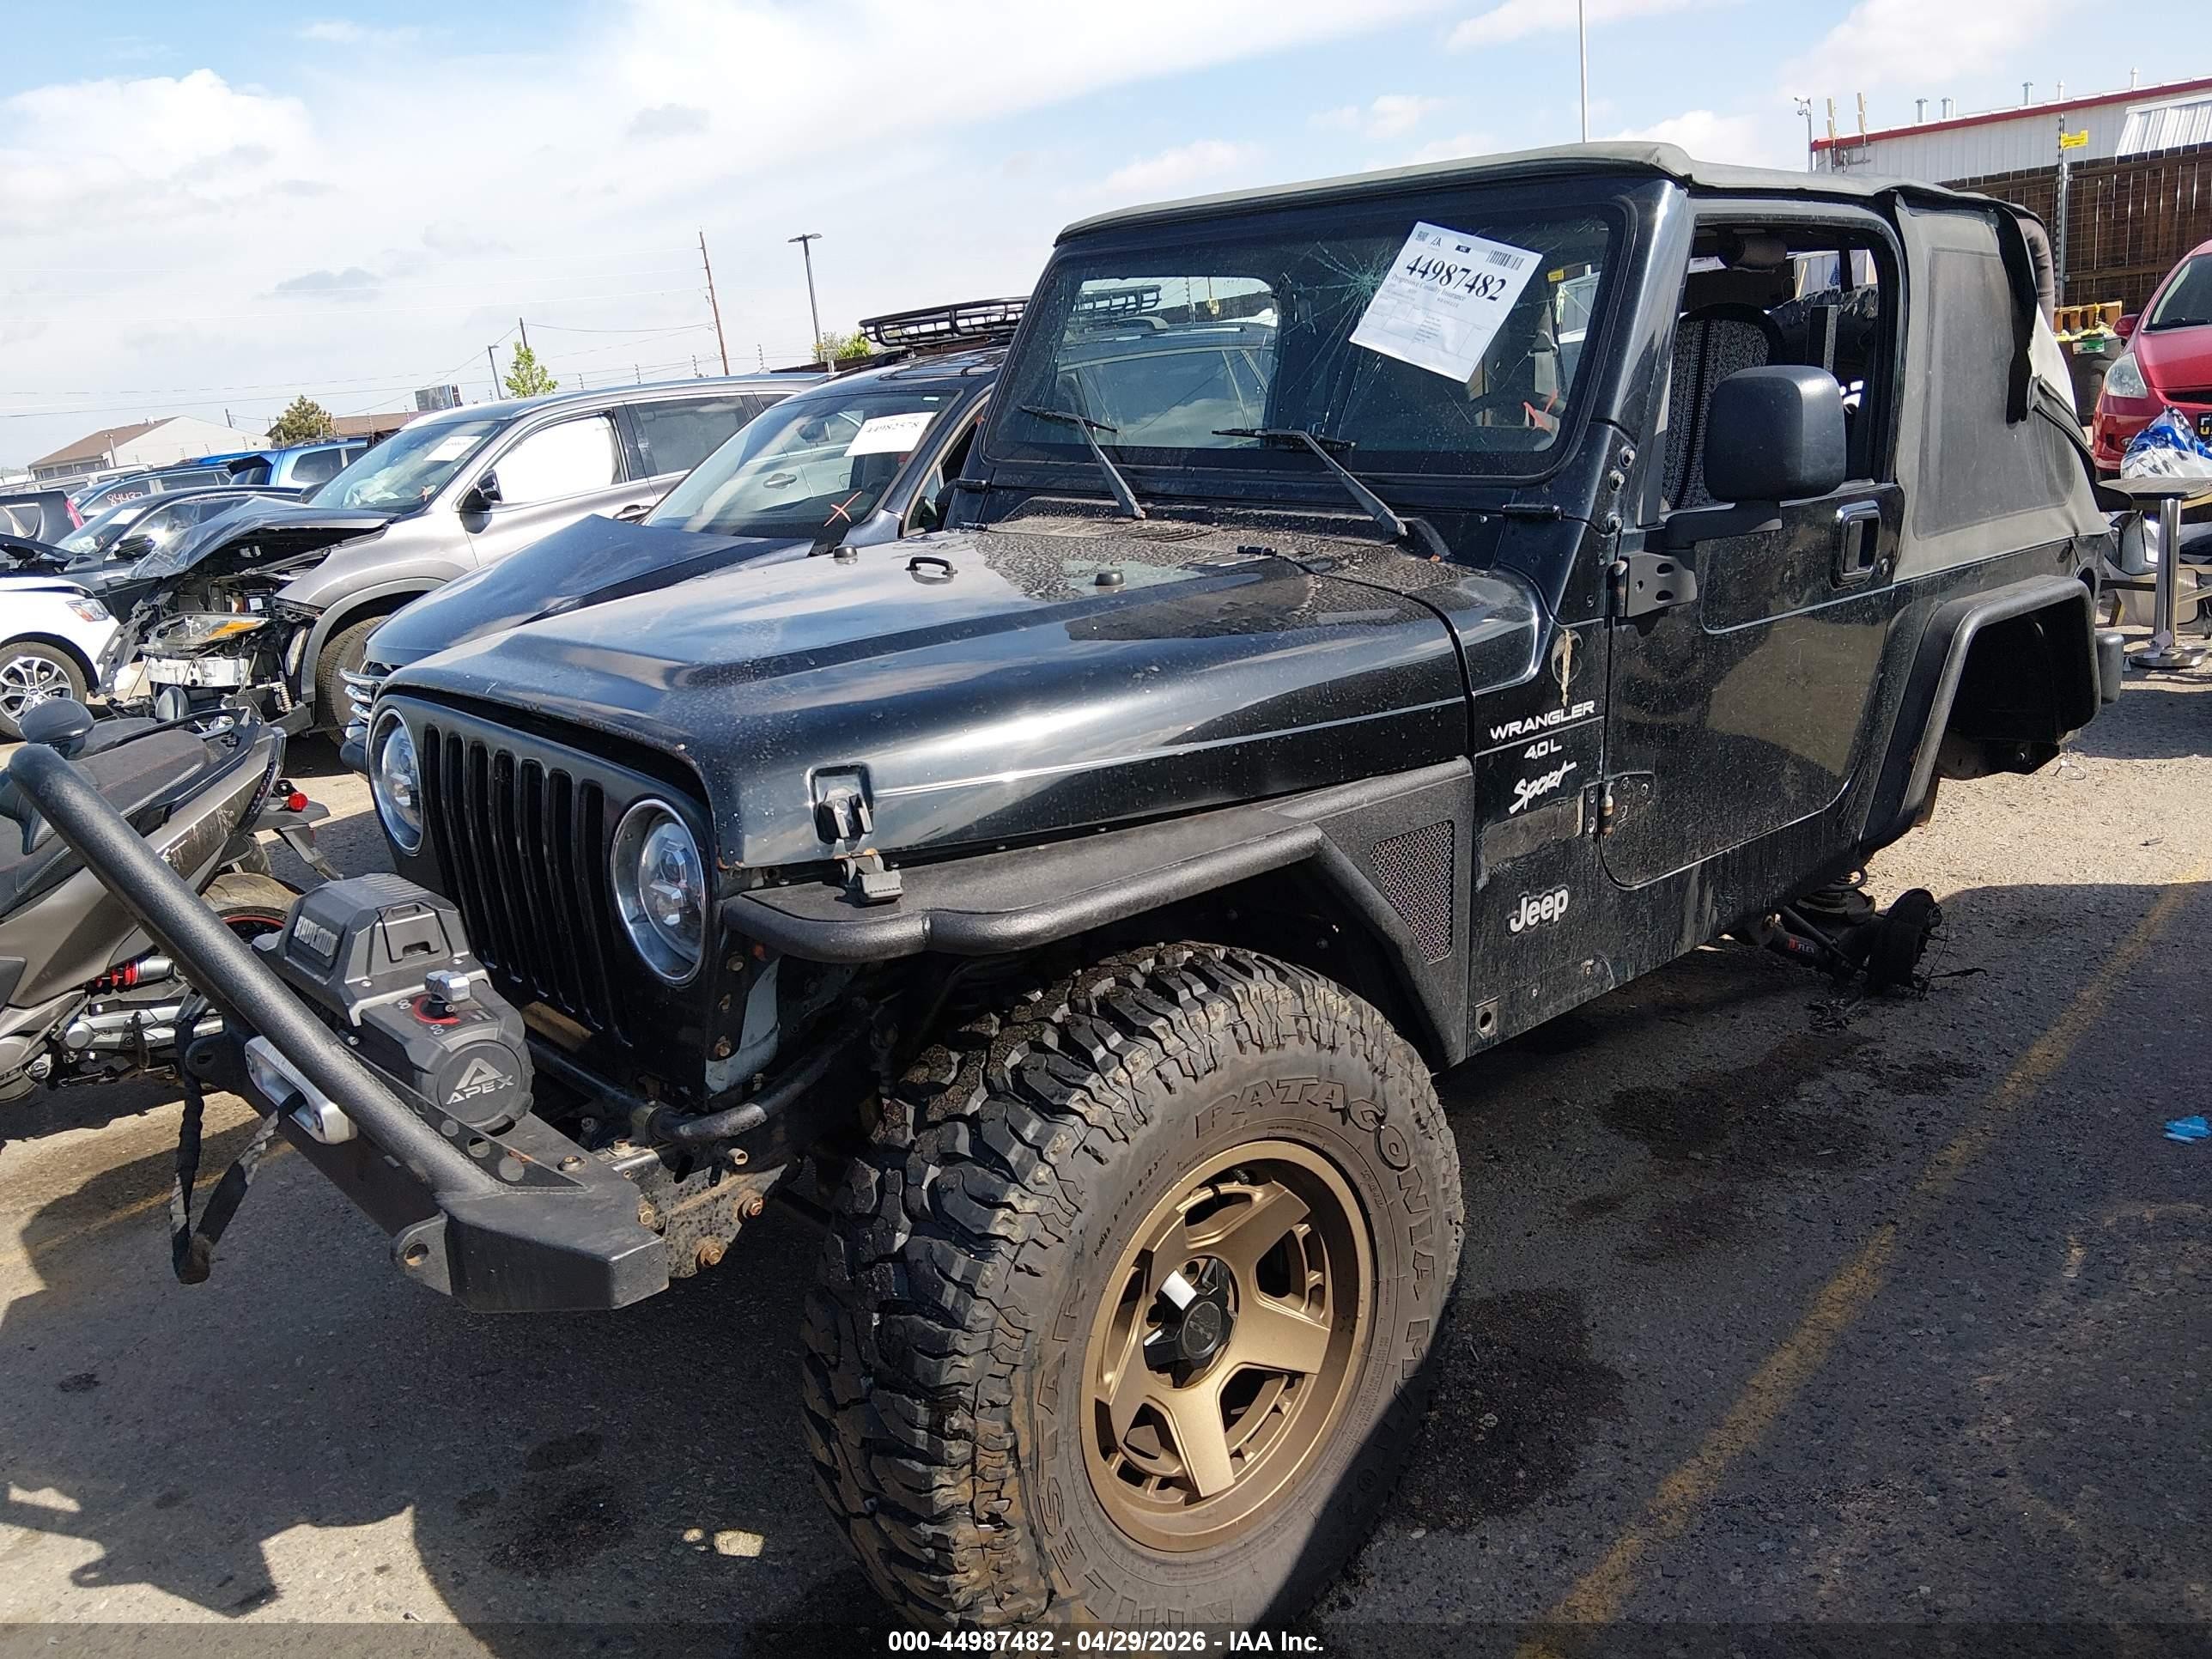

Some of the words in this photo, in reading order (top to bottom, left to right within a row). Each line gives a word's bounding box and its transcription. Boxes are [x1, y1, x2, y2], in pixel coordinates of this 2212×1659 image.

[1406, 254, 1506, 301] 44987482
[1490, 700, 1595, 740] WRANGLER
[1510, 889, 1569, 933] Jeep
[446, 1074, 515, 1105] APEX
